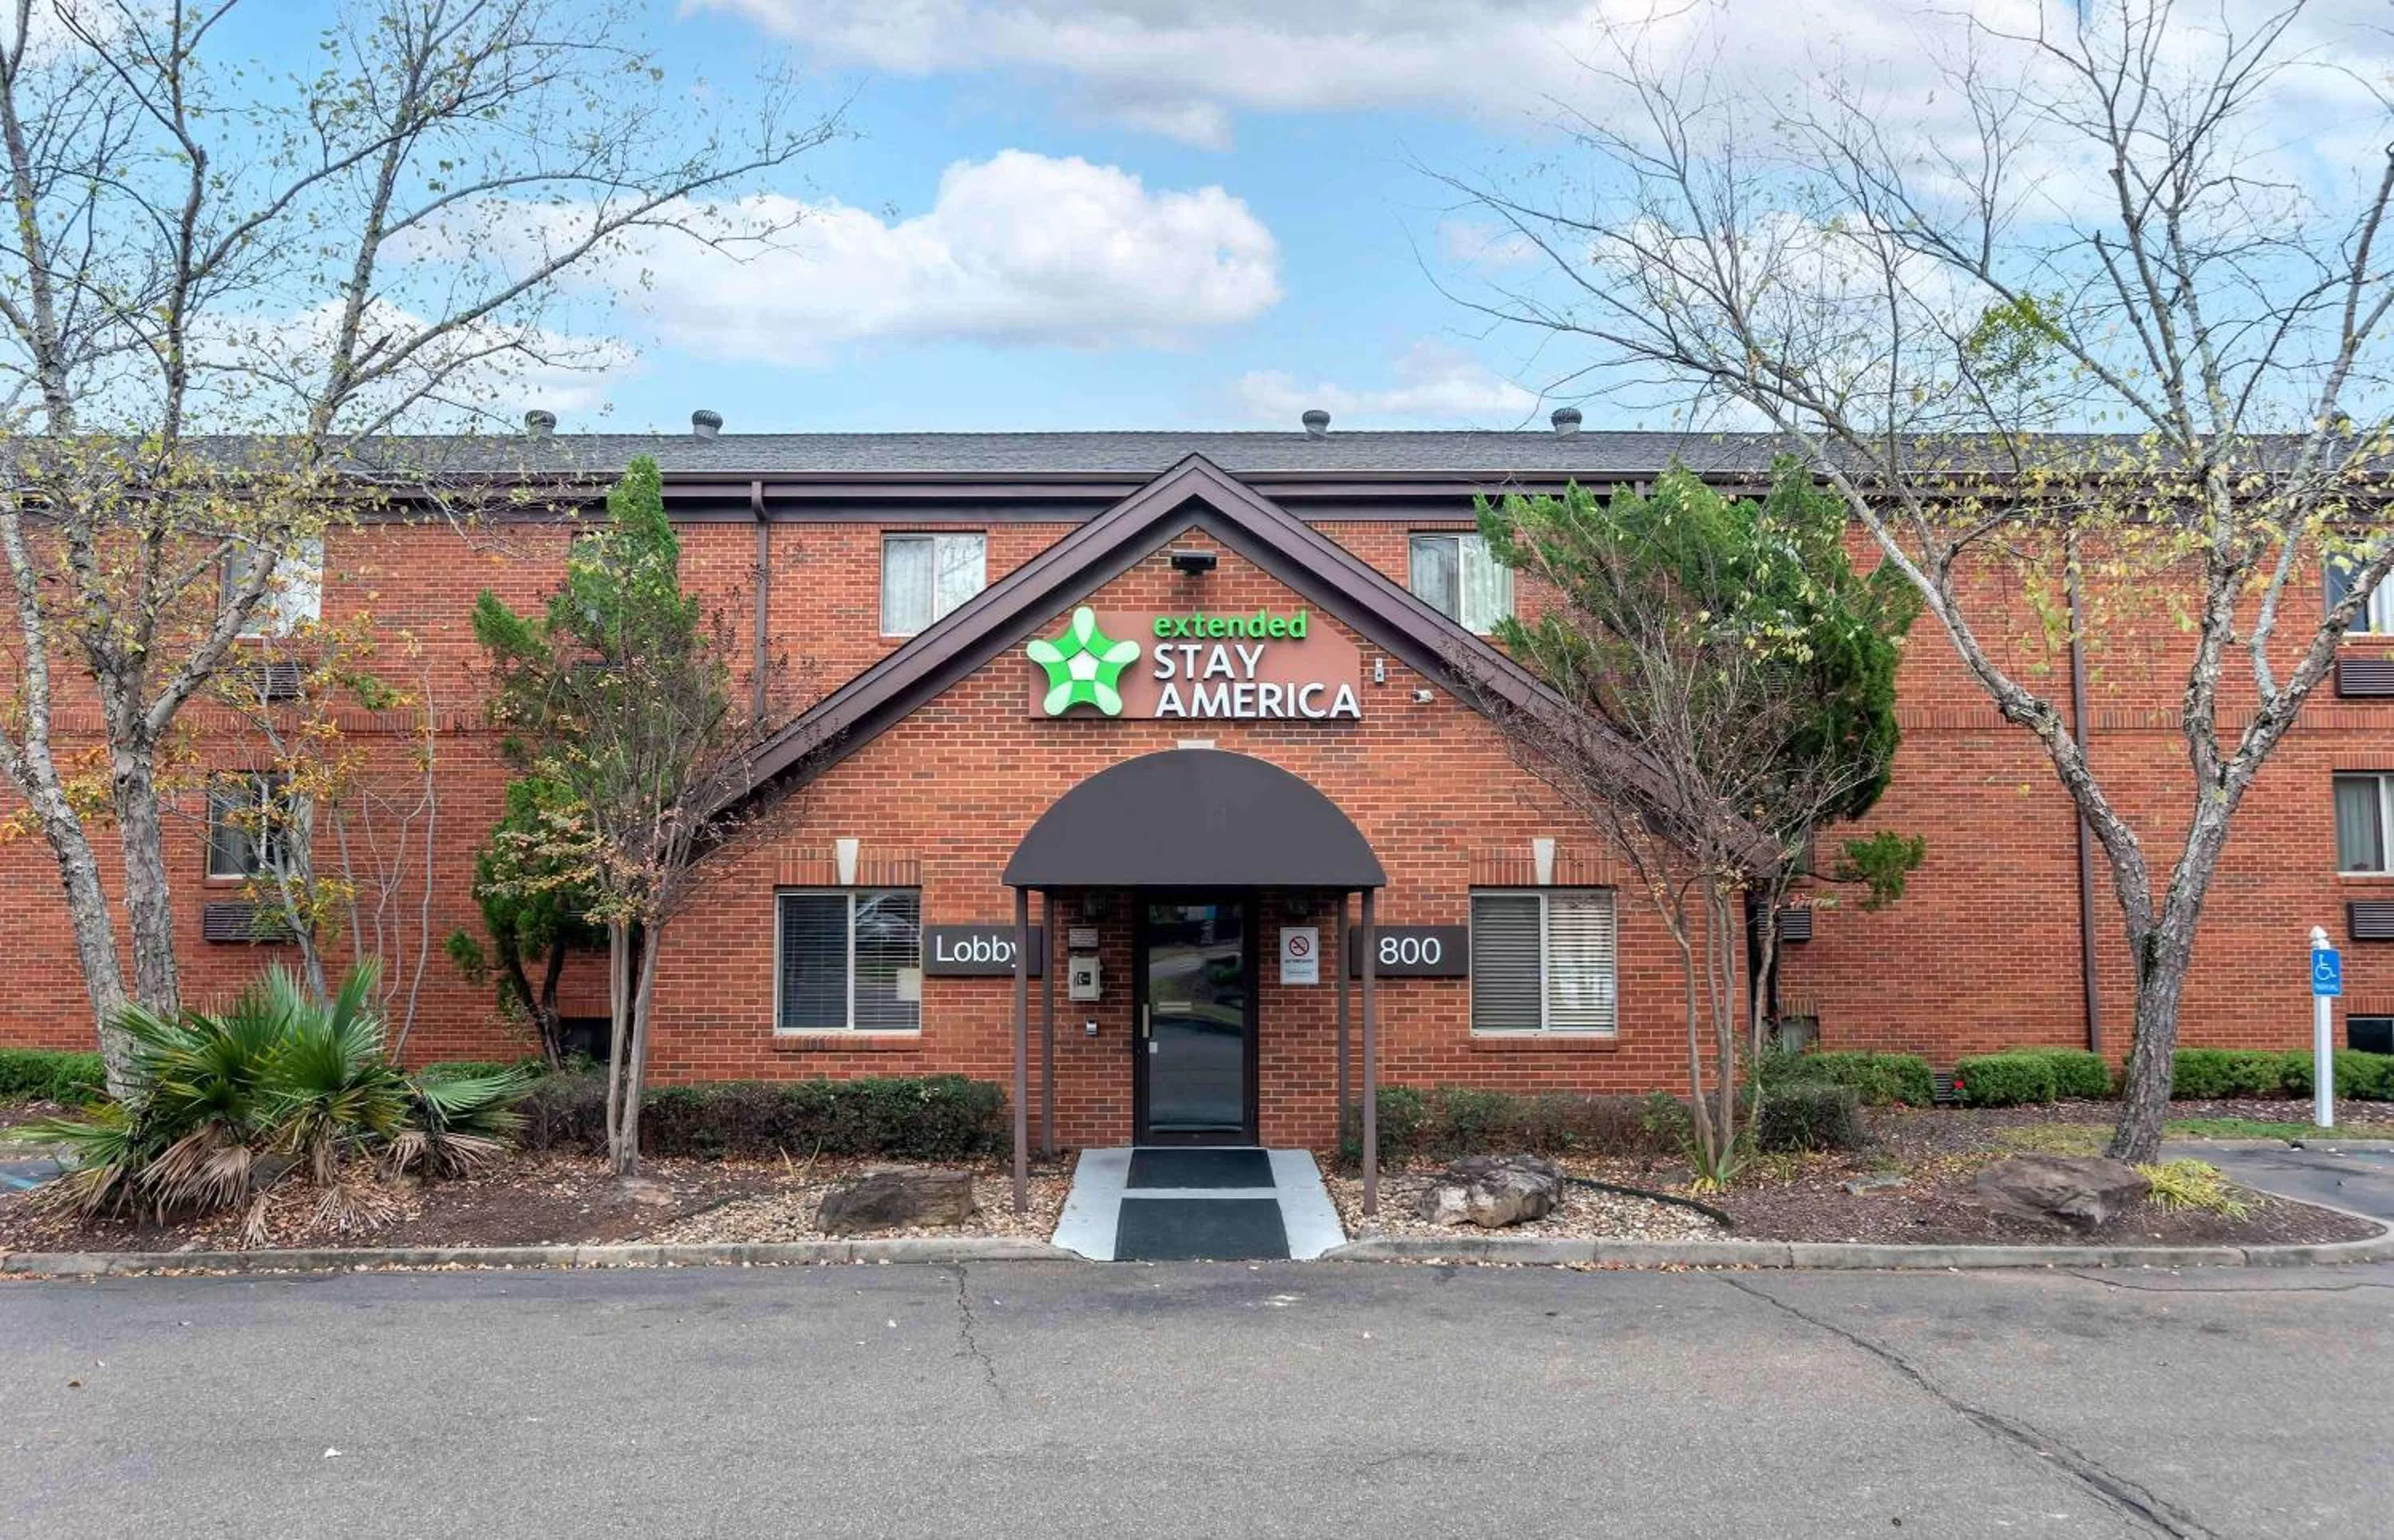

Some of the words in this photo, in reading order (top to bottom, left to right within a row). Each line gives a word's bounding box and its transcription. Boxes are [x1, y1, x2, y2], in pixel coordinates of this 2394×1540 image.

[1154, 607, 1308, 639] extended
[1153, 643, 1265, 679] STAY
[1155, 683, 1361, 717] AMERICA
[1379, 937, 1441, 965] 800
